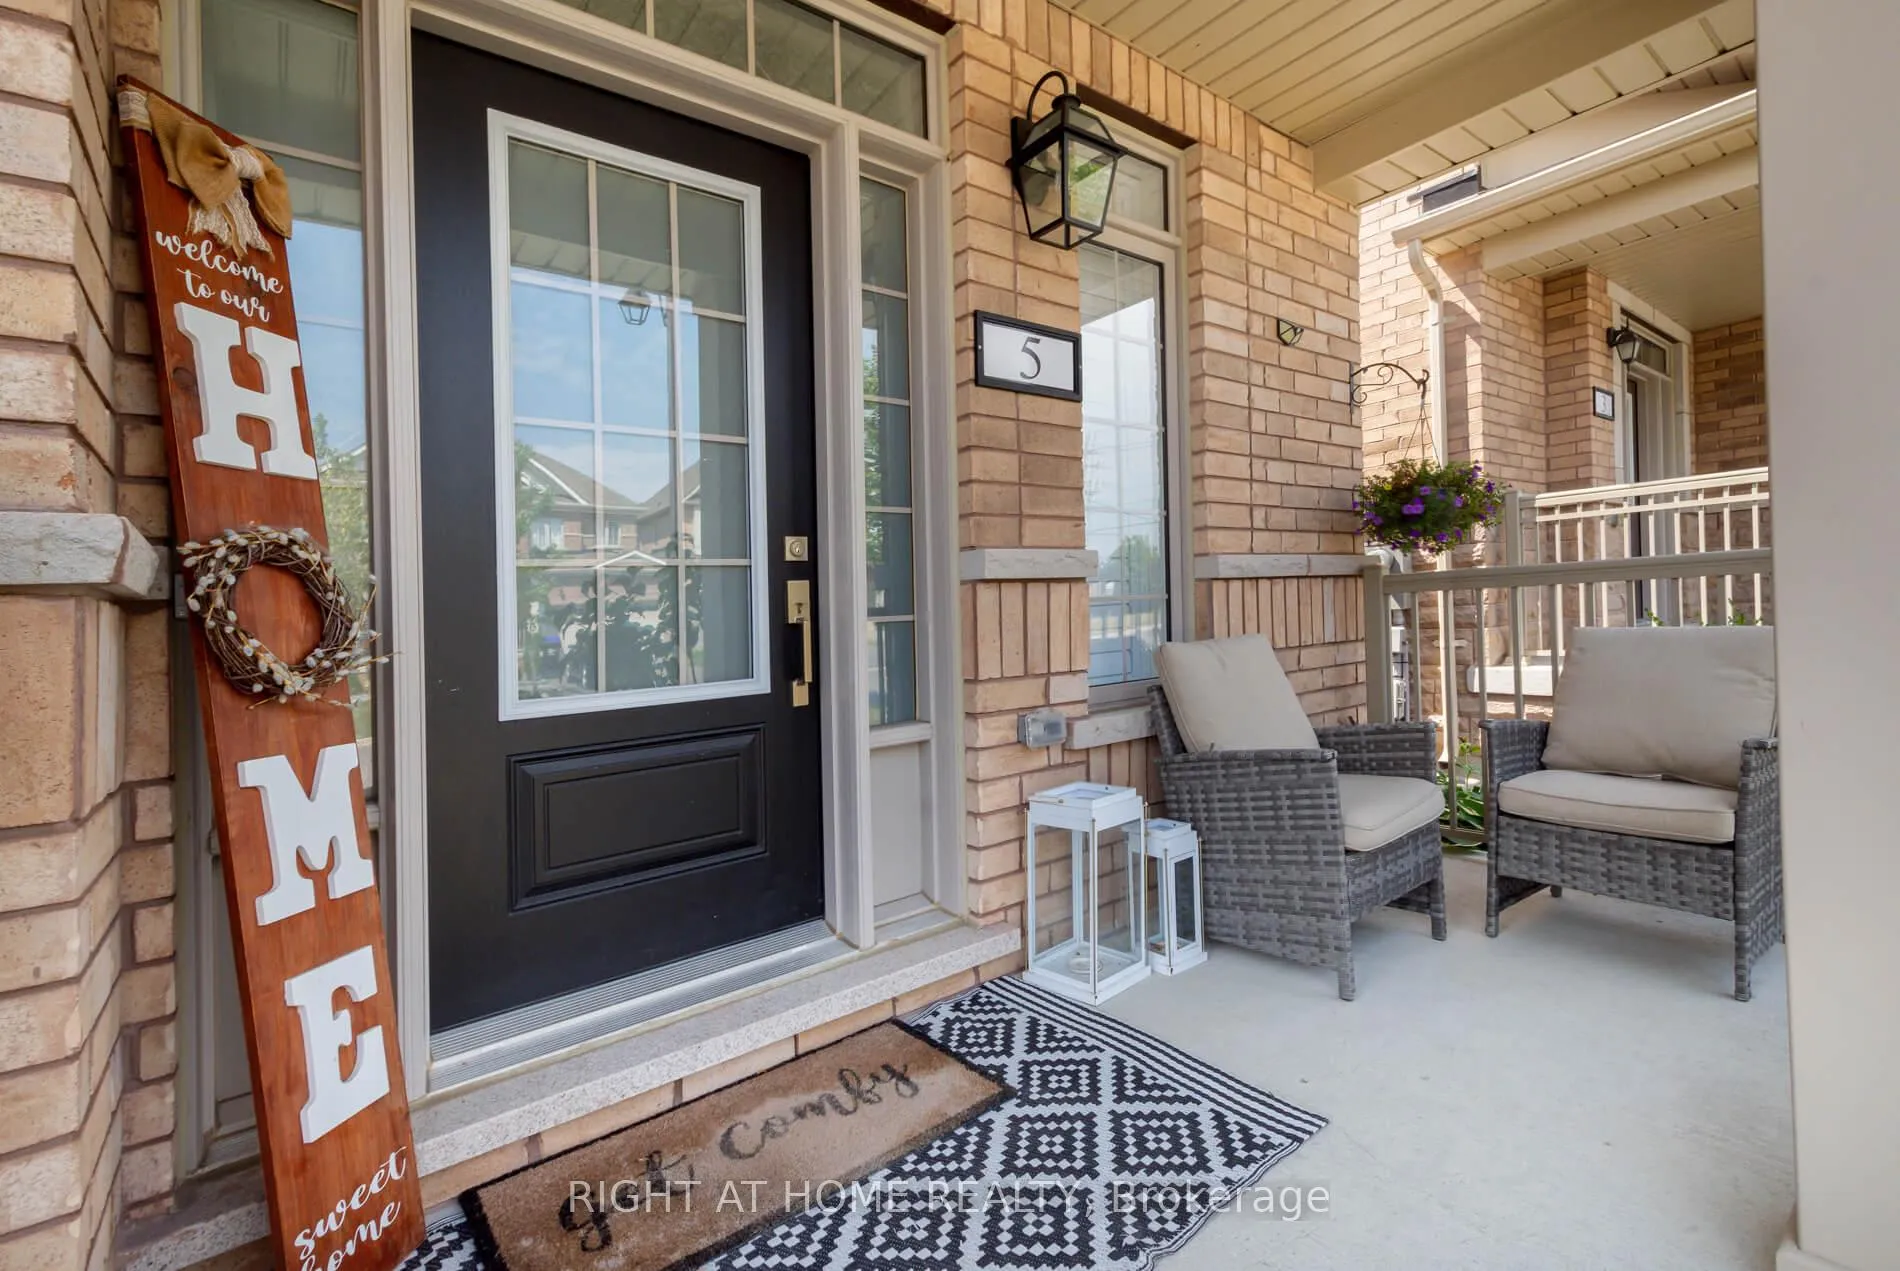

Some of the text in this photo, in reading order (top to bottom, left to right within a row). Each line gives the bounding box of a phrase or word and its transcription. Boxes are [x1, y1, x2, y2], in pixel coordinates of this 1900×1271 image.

[155, 231, 284, 294] welcome
[177, 268, 271, 323] to our
[1020, 336, 1041, 380] 5
[294, 1146, 407, 1260] sweet
